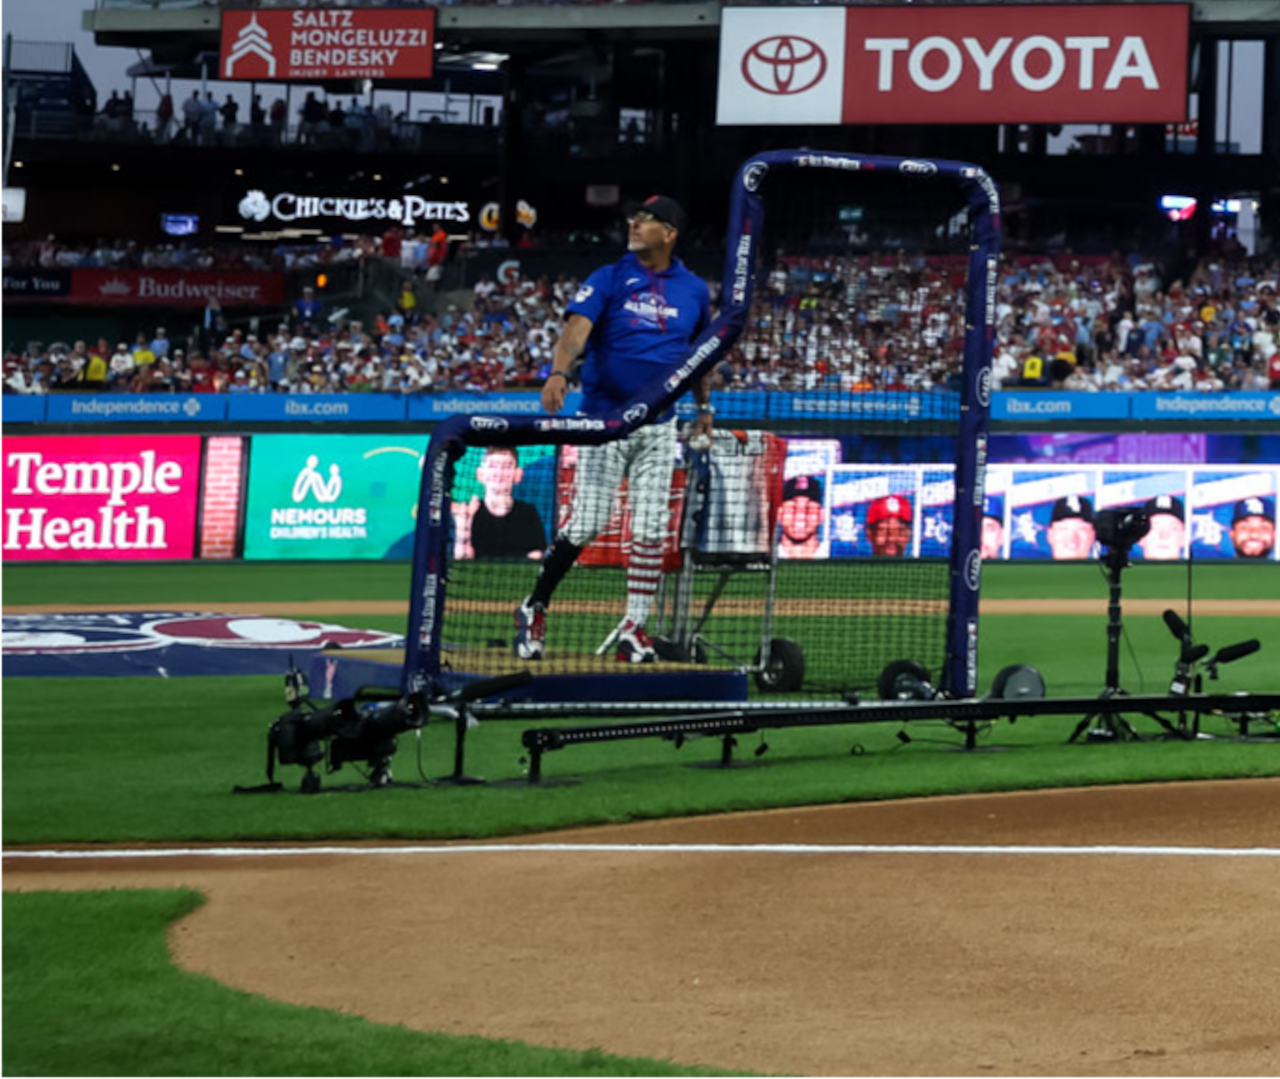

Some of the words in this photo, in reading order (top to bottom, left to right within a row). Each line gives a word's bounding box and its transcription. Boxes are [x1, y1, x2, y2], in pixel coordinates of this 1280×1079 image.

[292, 10, 353, 27] SALTZ
[290, 29, 427, 46] MONGELUZZI
[290, 49, 398, 66] BENDESKY
[864, 35, 1160, 92] TOYOTA
[137, 277, 261, 299] Budweiser
[72, 398, 181, 416] Independence
[284, 399, 349, 415] ibx.com
[432, 398, 541, 414] Independence
[1006, 397, 1072, 414] ibx.com
[1156, 396, 1267, 415] Independence
[7, 450, 183, 506] Temple
[270, 508, 368, 524] NEMOURS
[3, 506, 168, 551] Health
